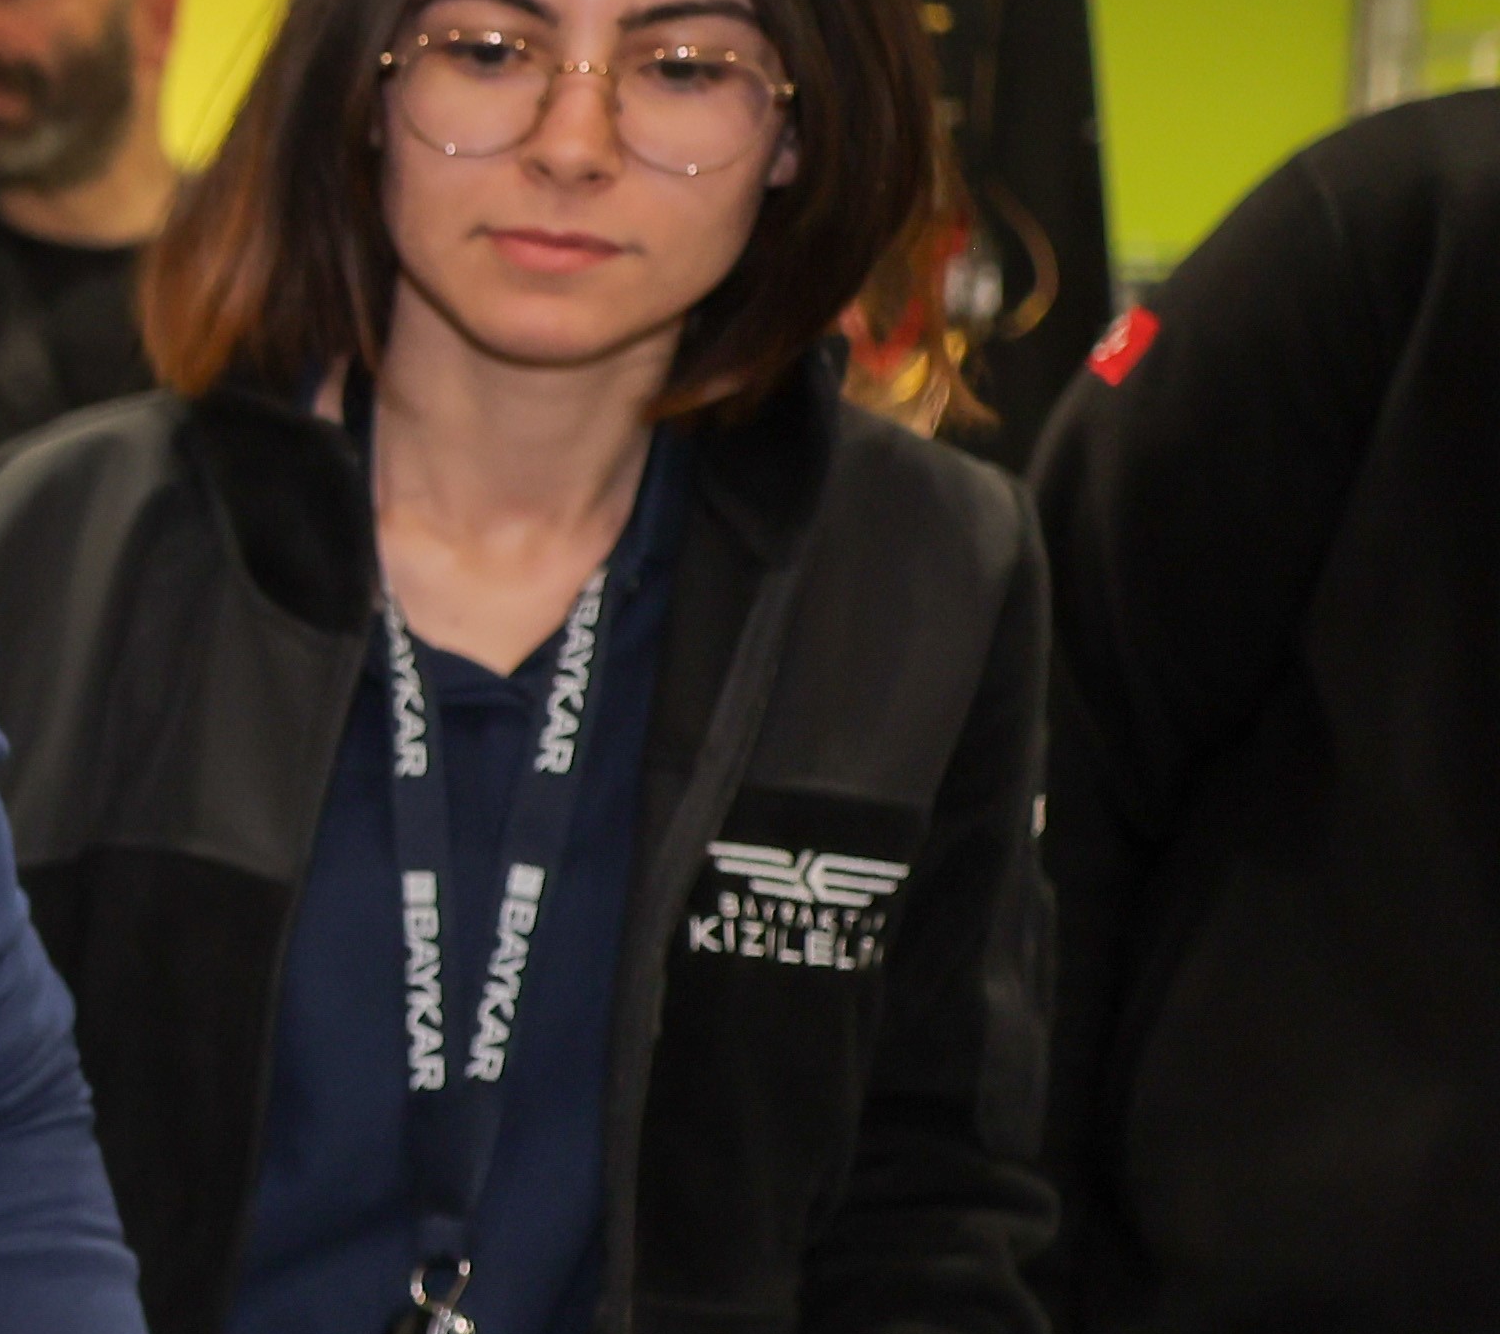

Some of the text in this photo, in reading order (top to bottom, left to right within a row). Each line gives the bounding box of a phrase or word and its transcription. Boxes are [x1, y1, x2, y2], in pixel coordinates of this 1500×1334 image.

[534, 595, 603, 773] BAYKAR
[402, 908, 446, 1091] BAYKAR
[465, 899, 538, 1083] BAYKAR
